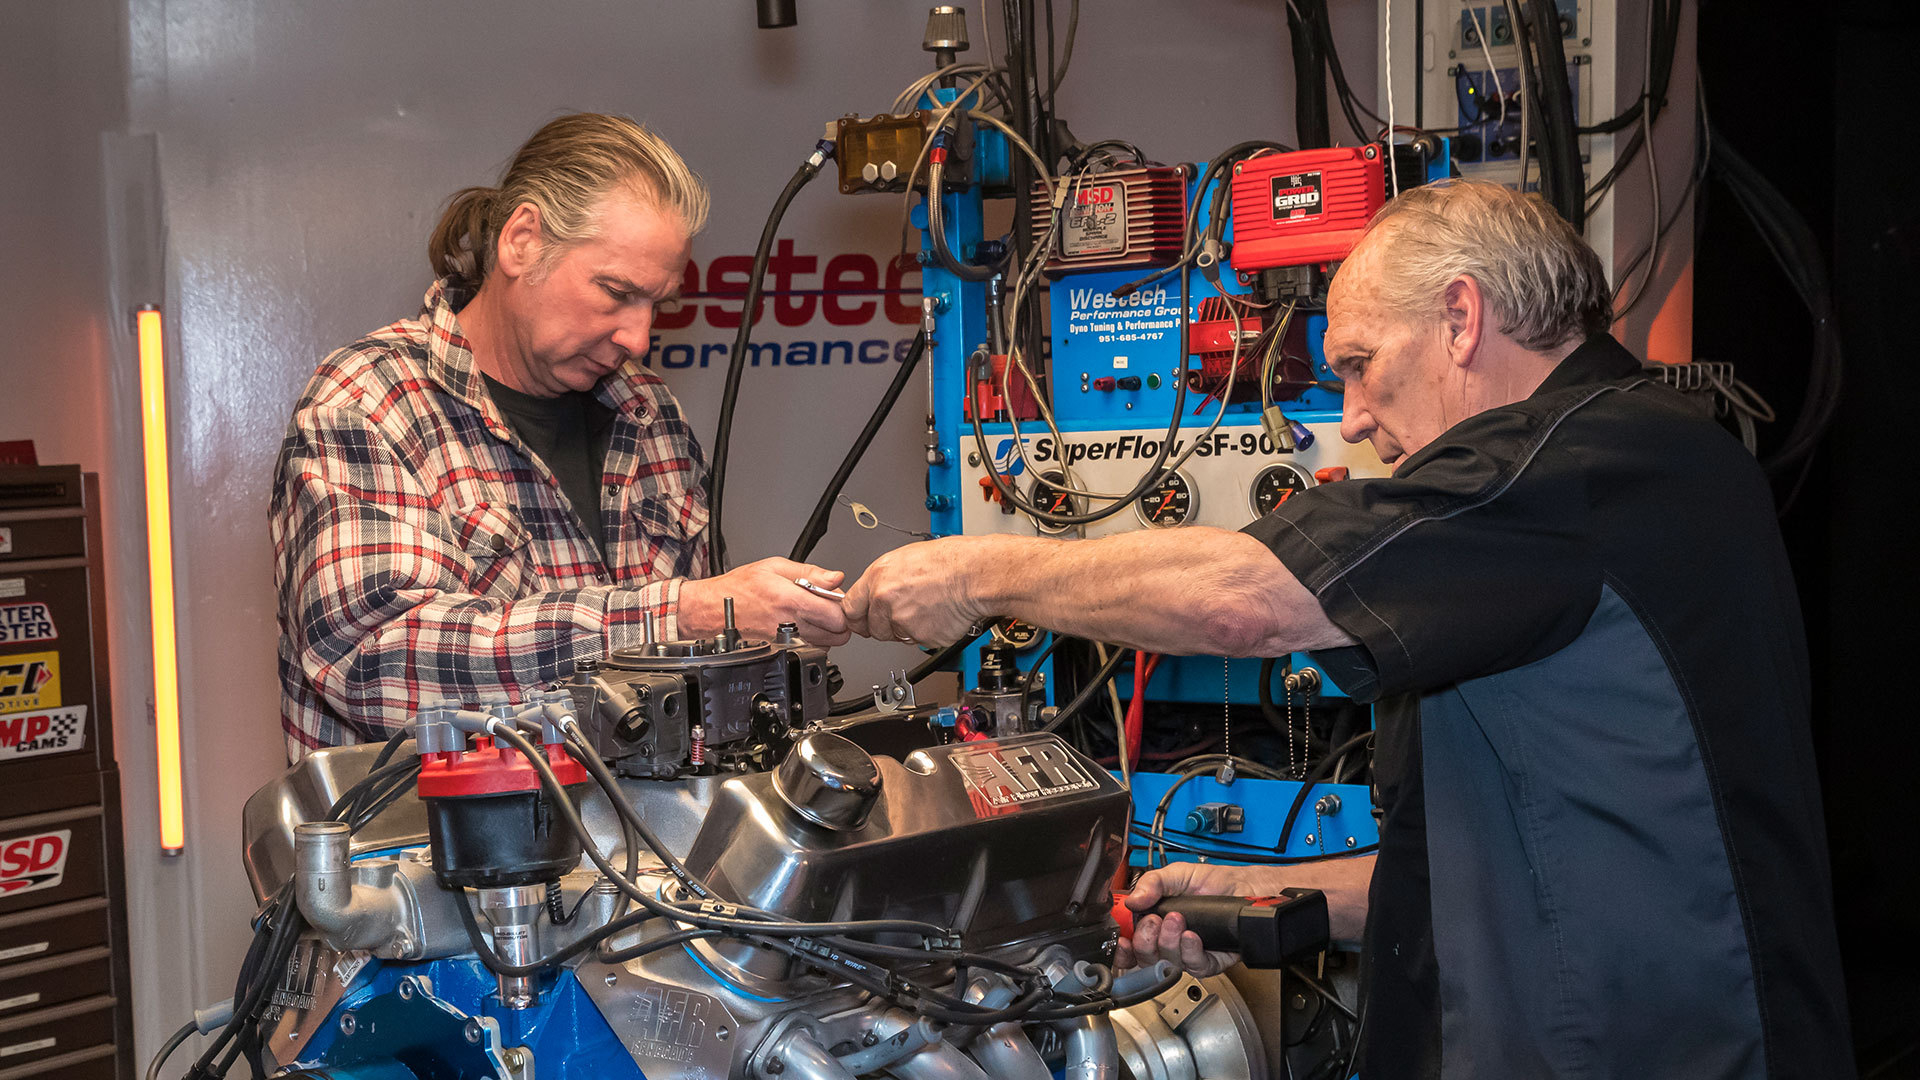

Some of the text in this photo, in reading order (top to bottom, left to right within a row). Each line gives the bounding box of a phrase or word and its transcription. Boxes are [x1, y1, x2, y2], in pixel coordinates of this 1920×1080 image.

[1275, 192, 1320, 207] GRID
[1070, 309, 1151, 321] Performance
[1069, 323, 1088, 335] Dyno
[1090, 321, 1115, 333] Tuning
[1117, 321, 1123, 331] &
[1125, 319, 1173, 330] Performance
[1099, 332, 1164, 343] 951-685-4767
[1034, 433, 1294, 466] SuperFlow SF-90
[0, 605, 46, 624] TER
[16, 736, 68, 752] CAMS
[0, 835, 63, 878] SD
